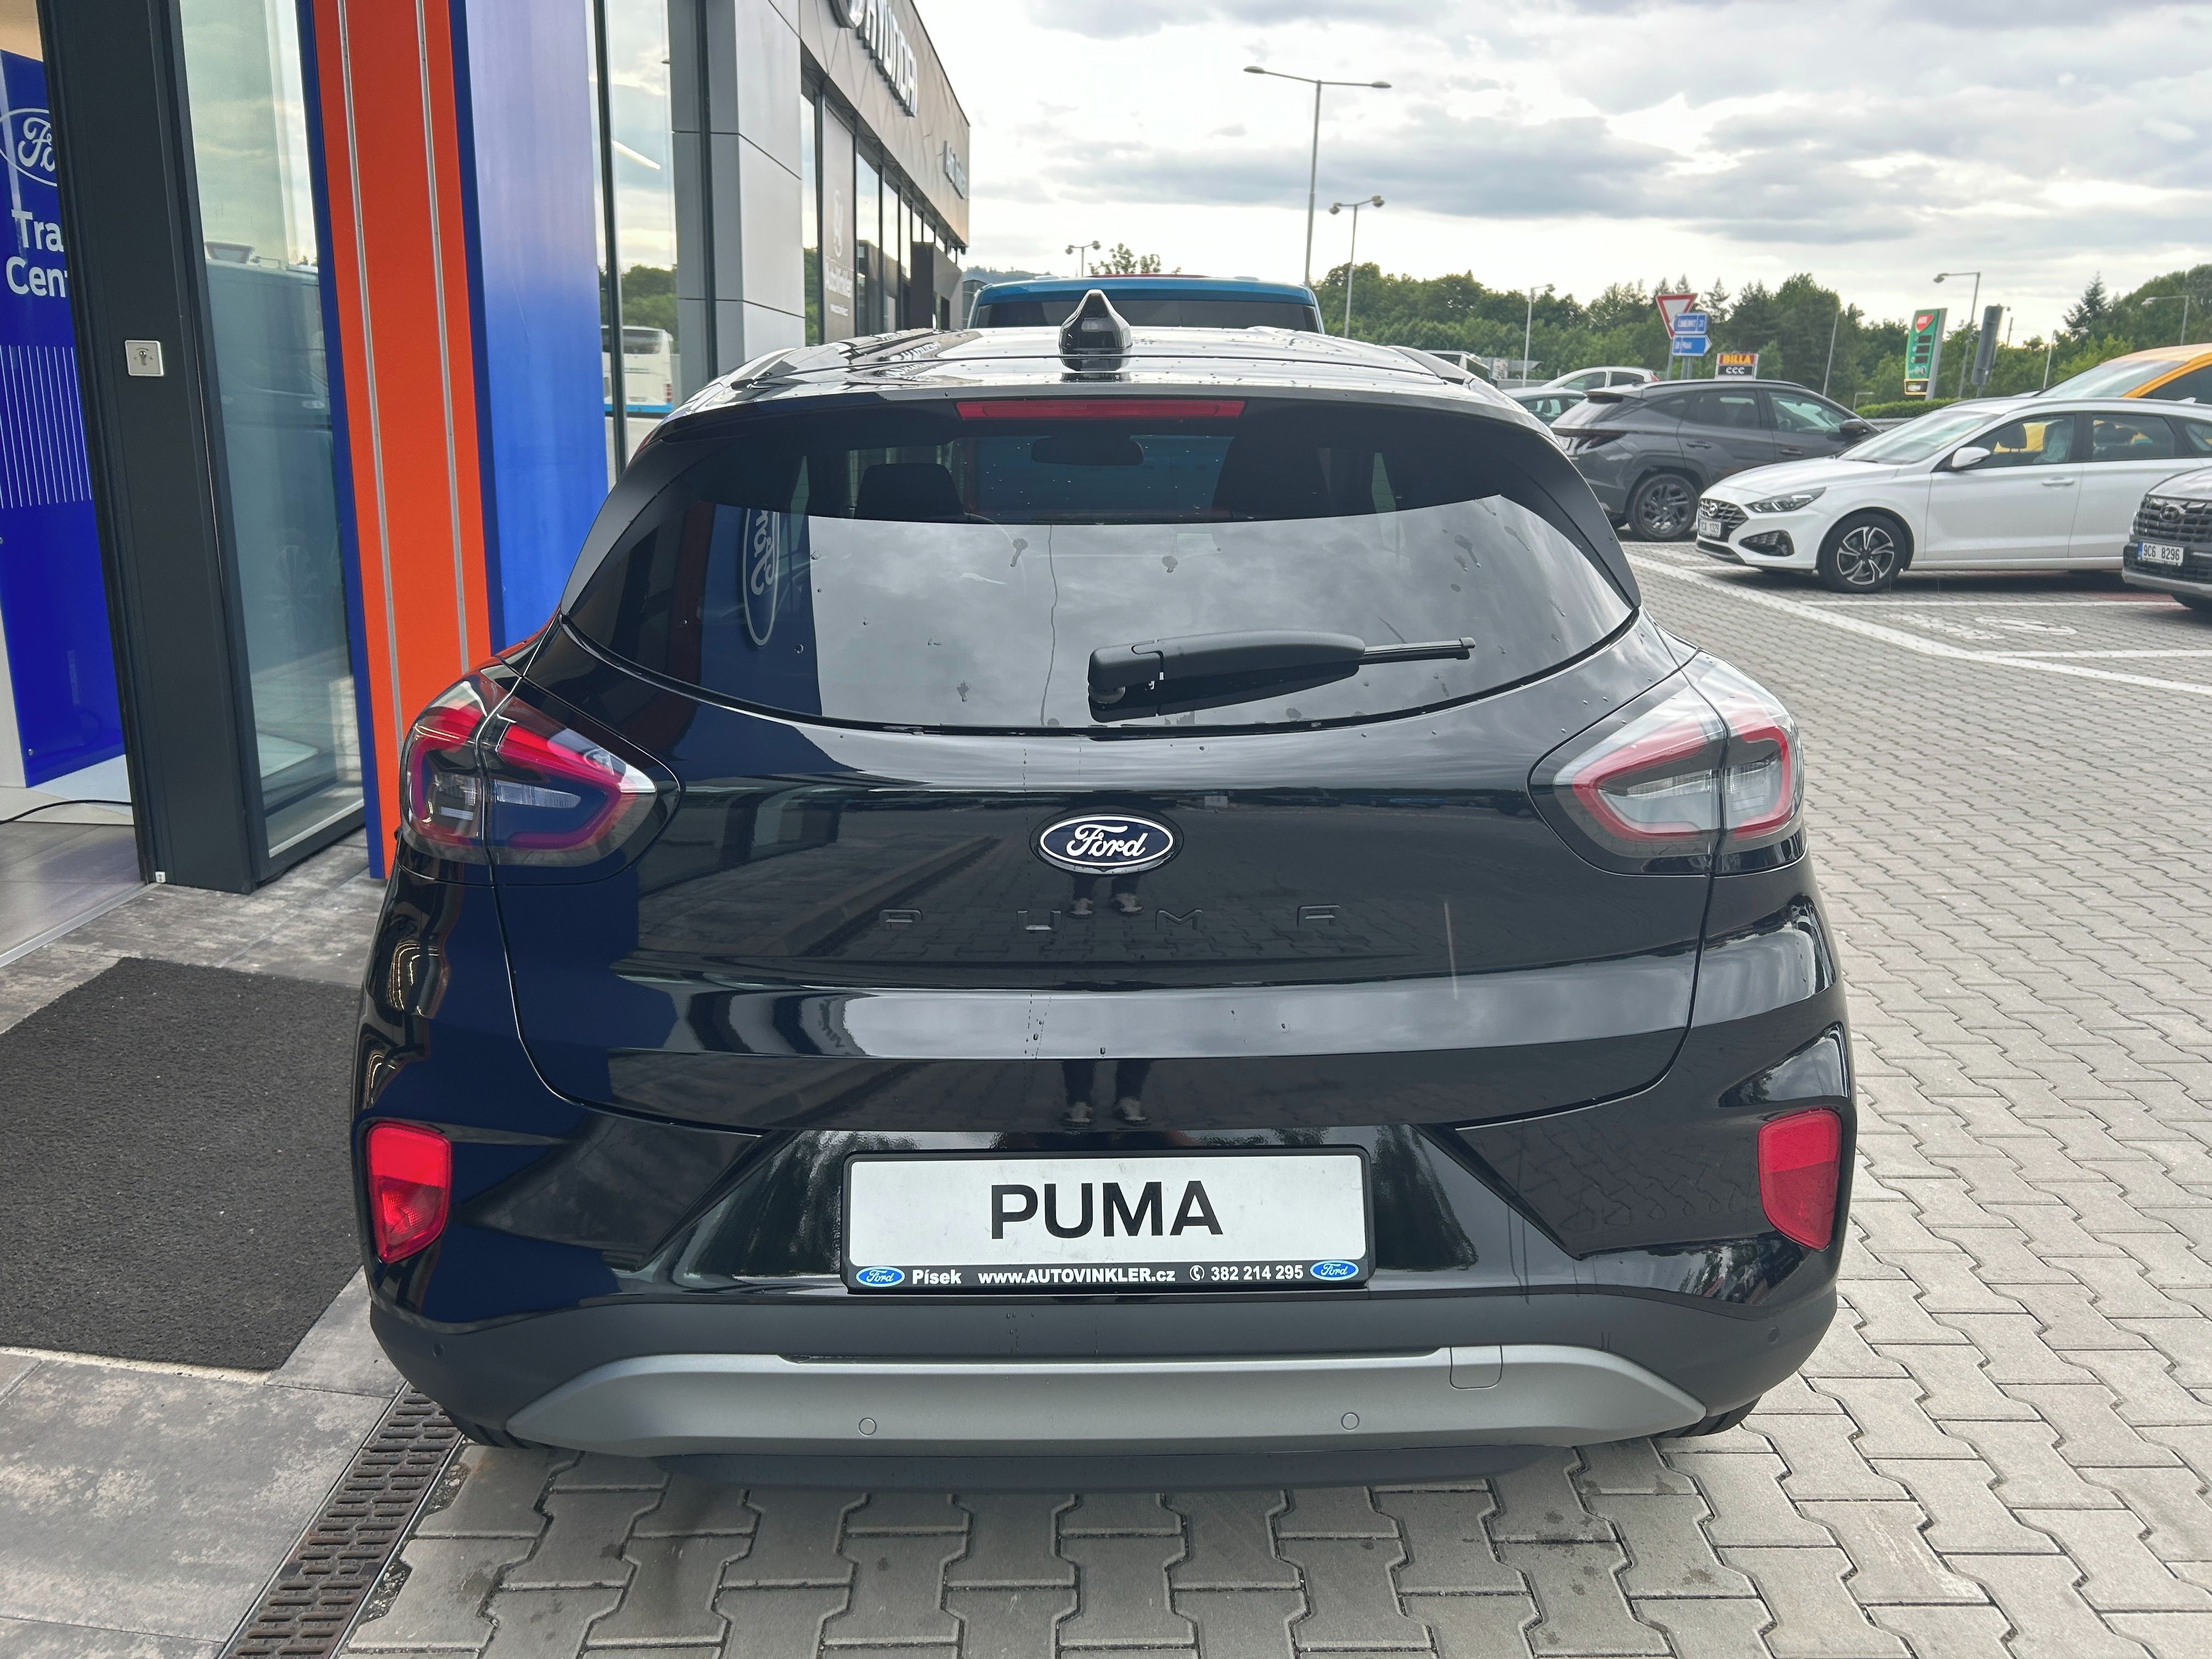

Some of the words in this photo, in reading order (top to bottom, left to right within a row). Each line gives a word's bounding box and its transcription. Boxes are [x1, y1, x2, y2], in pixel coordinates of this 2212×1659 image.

[6, 256, 67, 297] Cen
[1723, 354, 1752, 364] BILLA
[2162, 547, 2180, 561] 8296
[1066, 825, 1148, 856] Ford
[878, 904, 1342, 932] PUMA
[991, 1180, 1223, 1240] PUMA
[912, 1269, 962, 1284] Písek
[978, 1268, 1176, 1284] www.AUTOVINKLER.cz
[1211, 1266, 1239, 1281] 382
[1243, 1265, 1271, 1280] 214
[1275, 1265, 1304, 1280] 295
